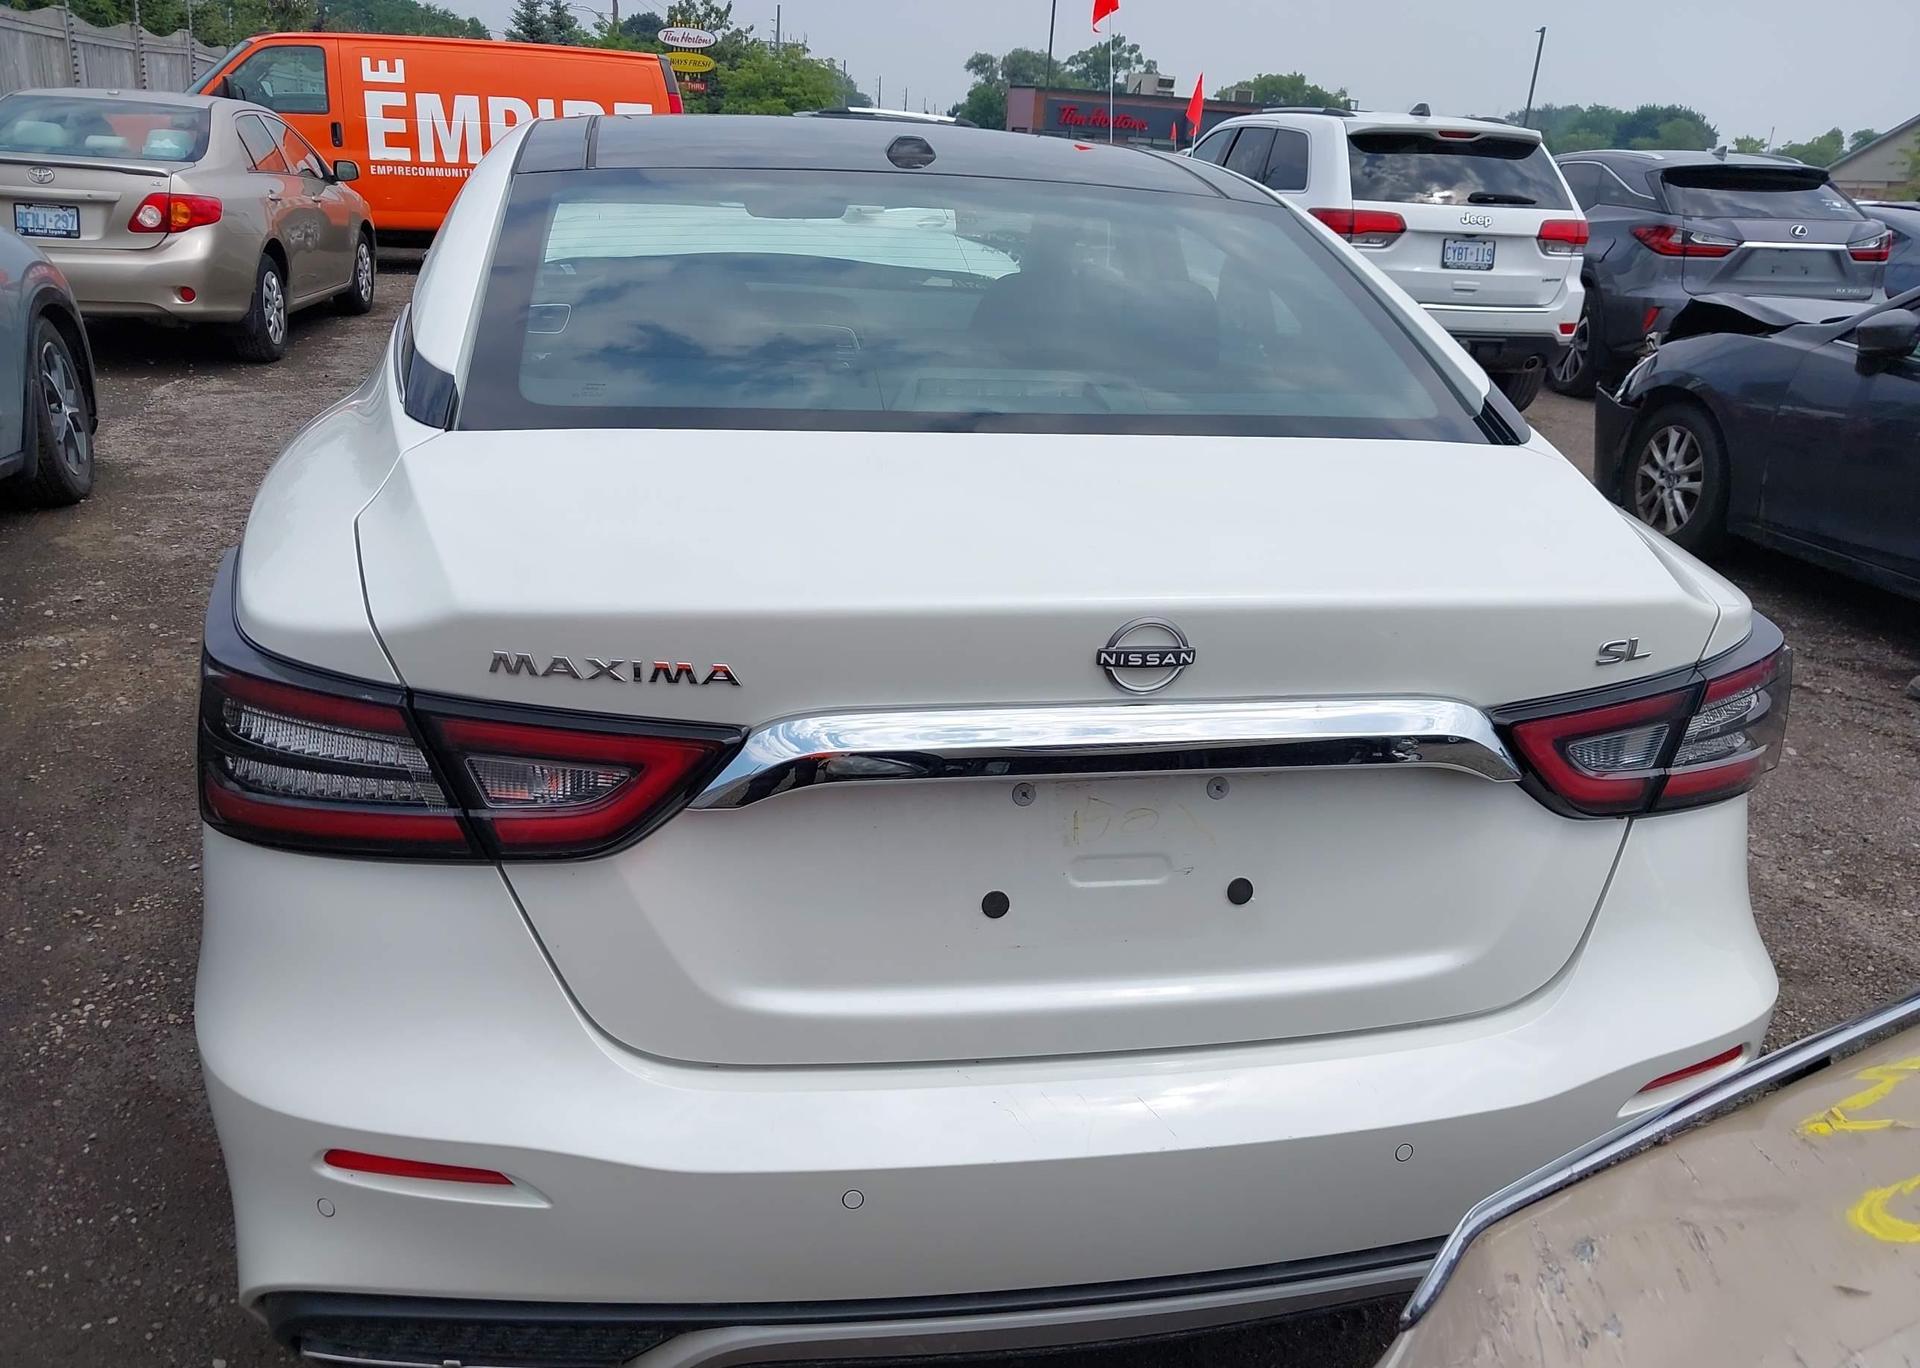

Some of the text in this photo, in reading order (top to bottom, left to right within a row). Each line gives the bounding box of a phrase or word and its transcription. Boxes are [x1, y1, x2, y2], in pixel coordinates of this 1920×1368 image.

[663, 31, 712, 44] Tim Hortons
[1058, 104, 1086, 126] Tim
[364, 90, 652, 164] EMP
[1460, 211, 1493, 228] Jeep
[1100, 651, 1194, 666] NISSAN
[1595, 637, 1653, 667] SL
[488, 650, 743, 687] MAXIMA
